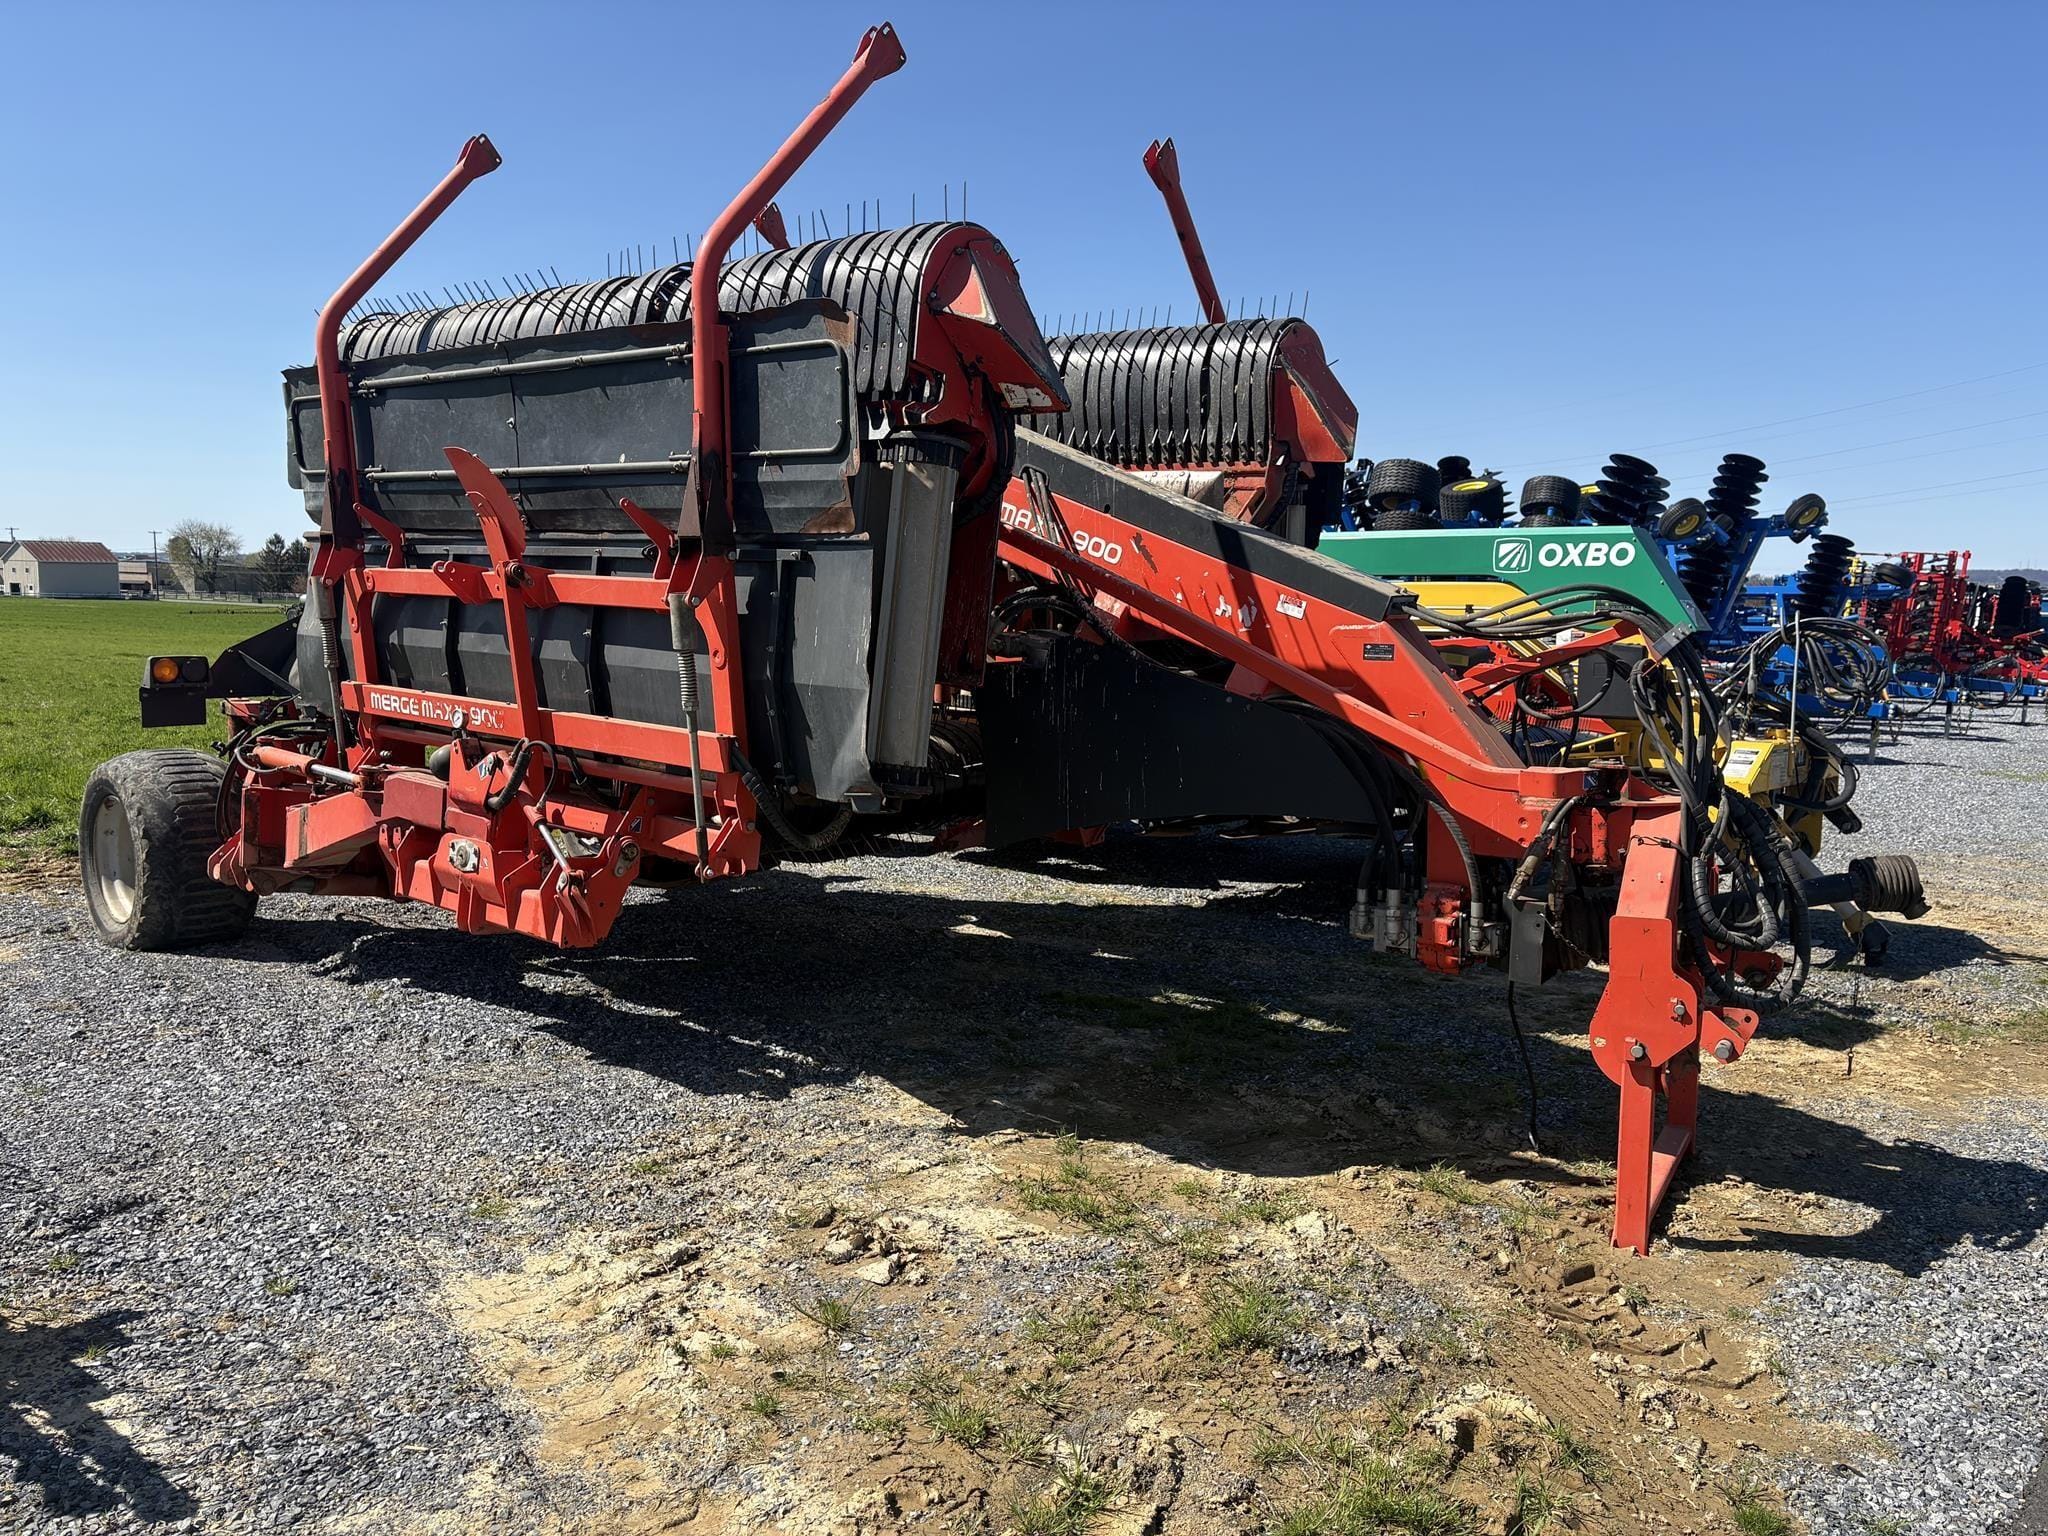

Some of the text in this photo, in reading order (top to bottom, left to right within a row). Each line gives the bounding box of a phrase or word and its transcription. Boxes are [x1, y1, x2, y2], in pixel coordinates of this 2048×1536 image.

[1072, 530, 1123, 565] 900
[1538, 541, 1636, 567] OXBO
[370, 691, 420, 716] MERGE
